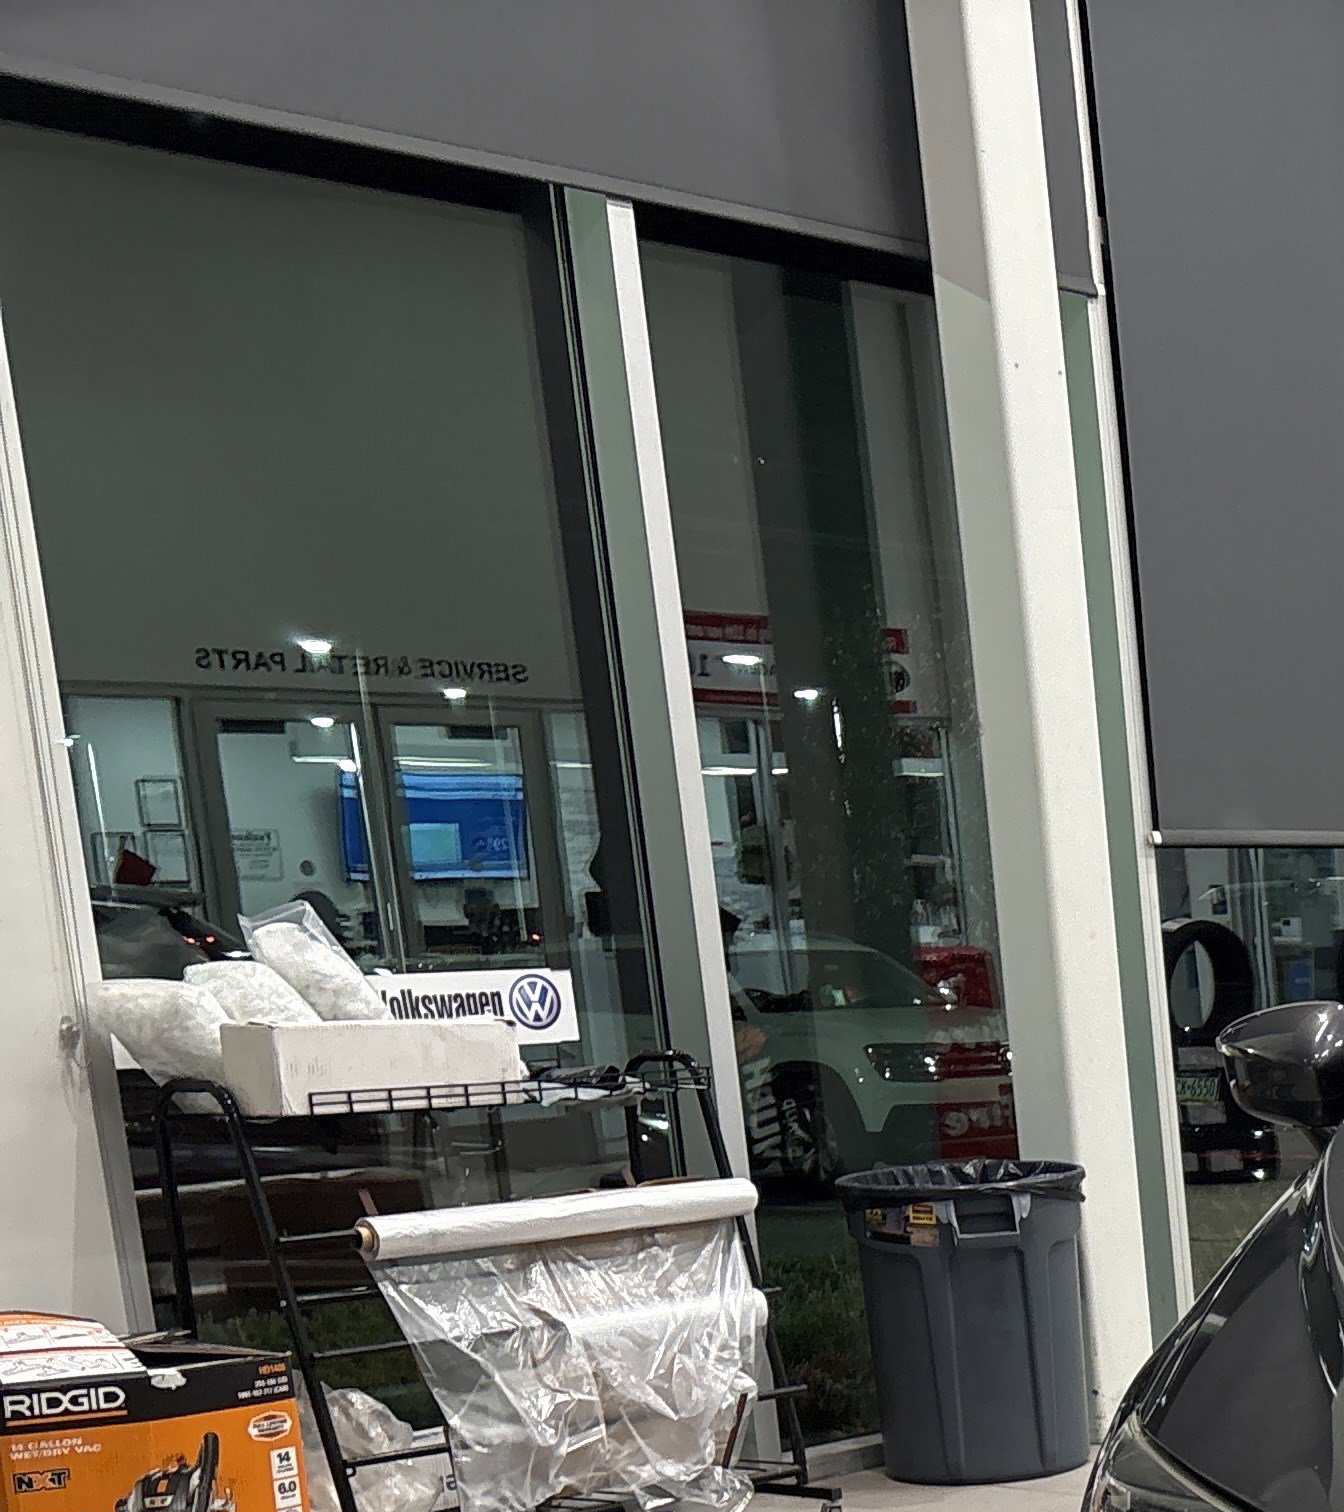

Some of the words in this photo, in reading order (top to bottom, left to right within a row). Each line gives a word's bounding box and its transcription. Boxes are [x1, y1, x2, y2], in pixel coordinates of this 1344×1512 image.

[3, 1385, 127, 1419] RIDGID
[27, 1436, 84, 1451] GALLON
[74, 1443, 102, 1454] VAC
[277, 1450, 292, 1464] 14
[278, 1480, 297, 1495] 6.0
